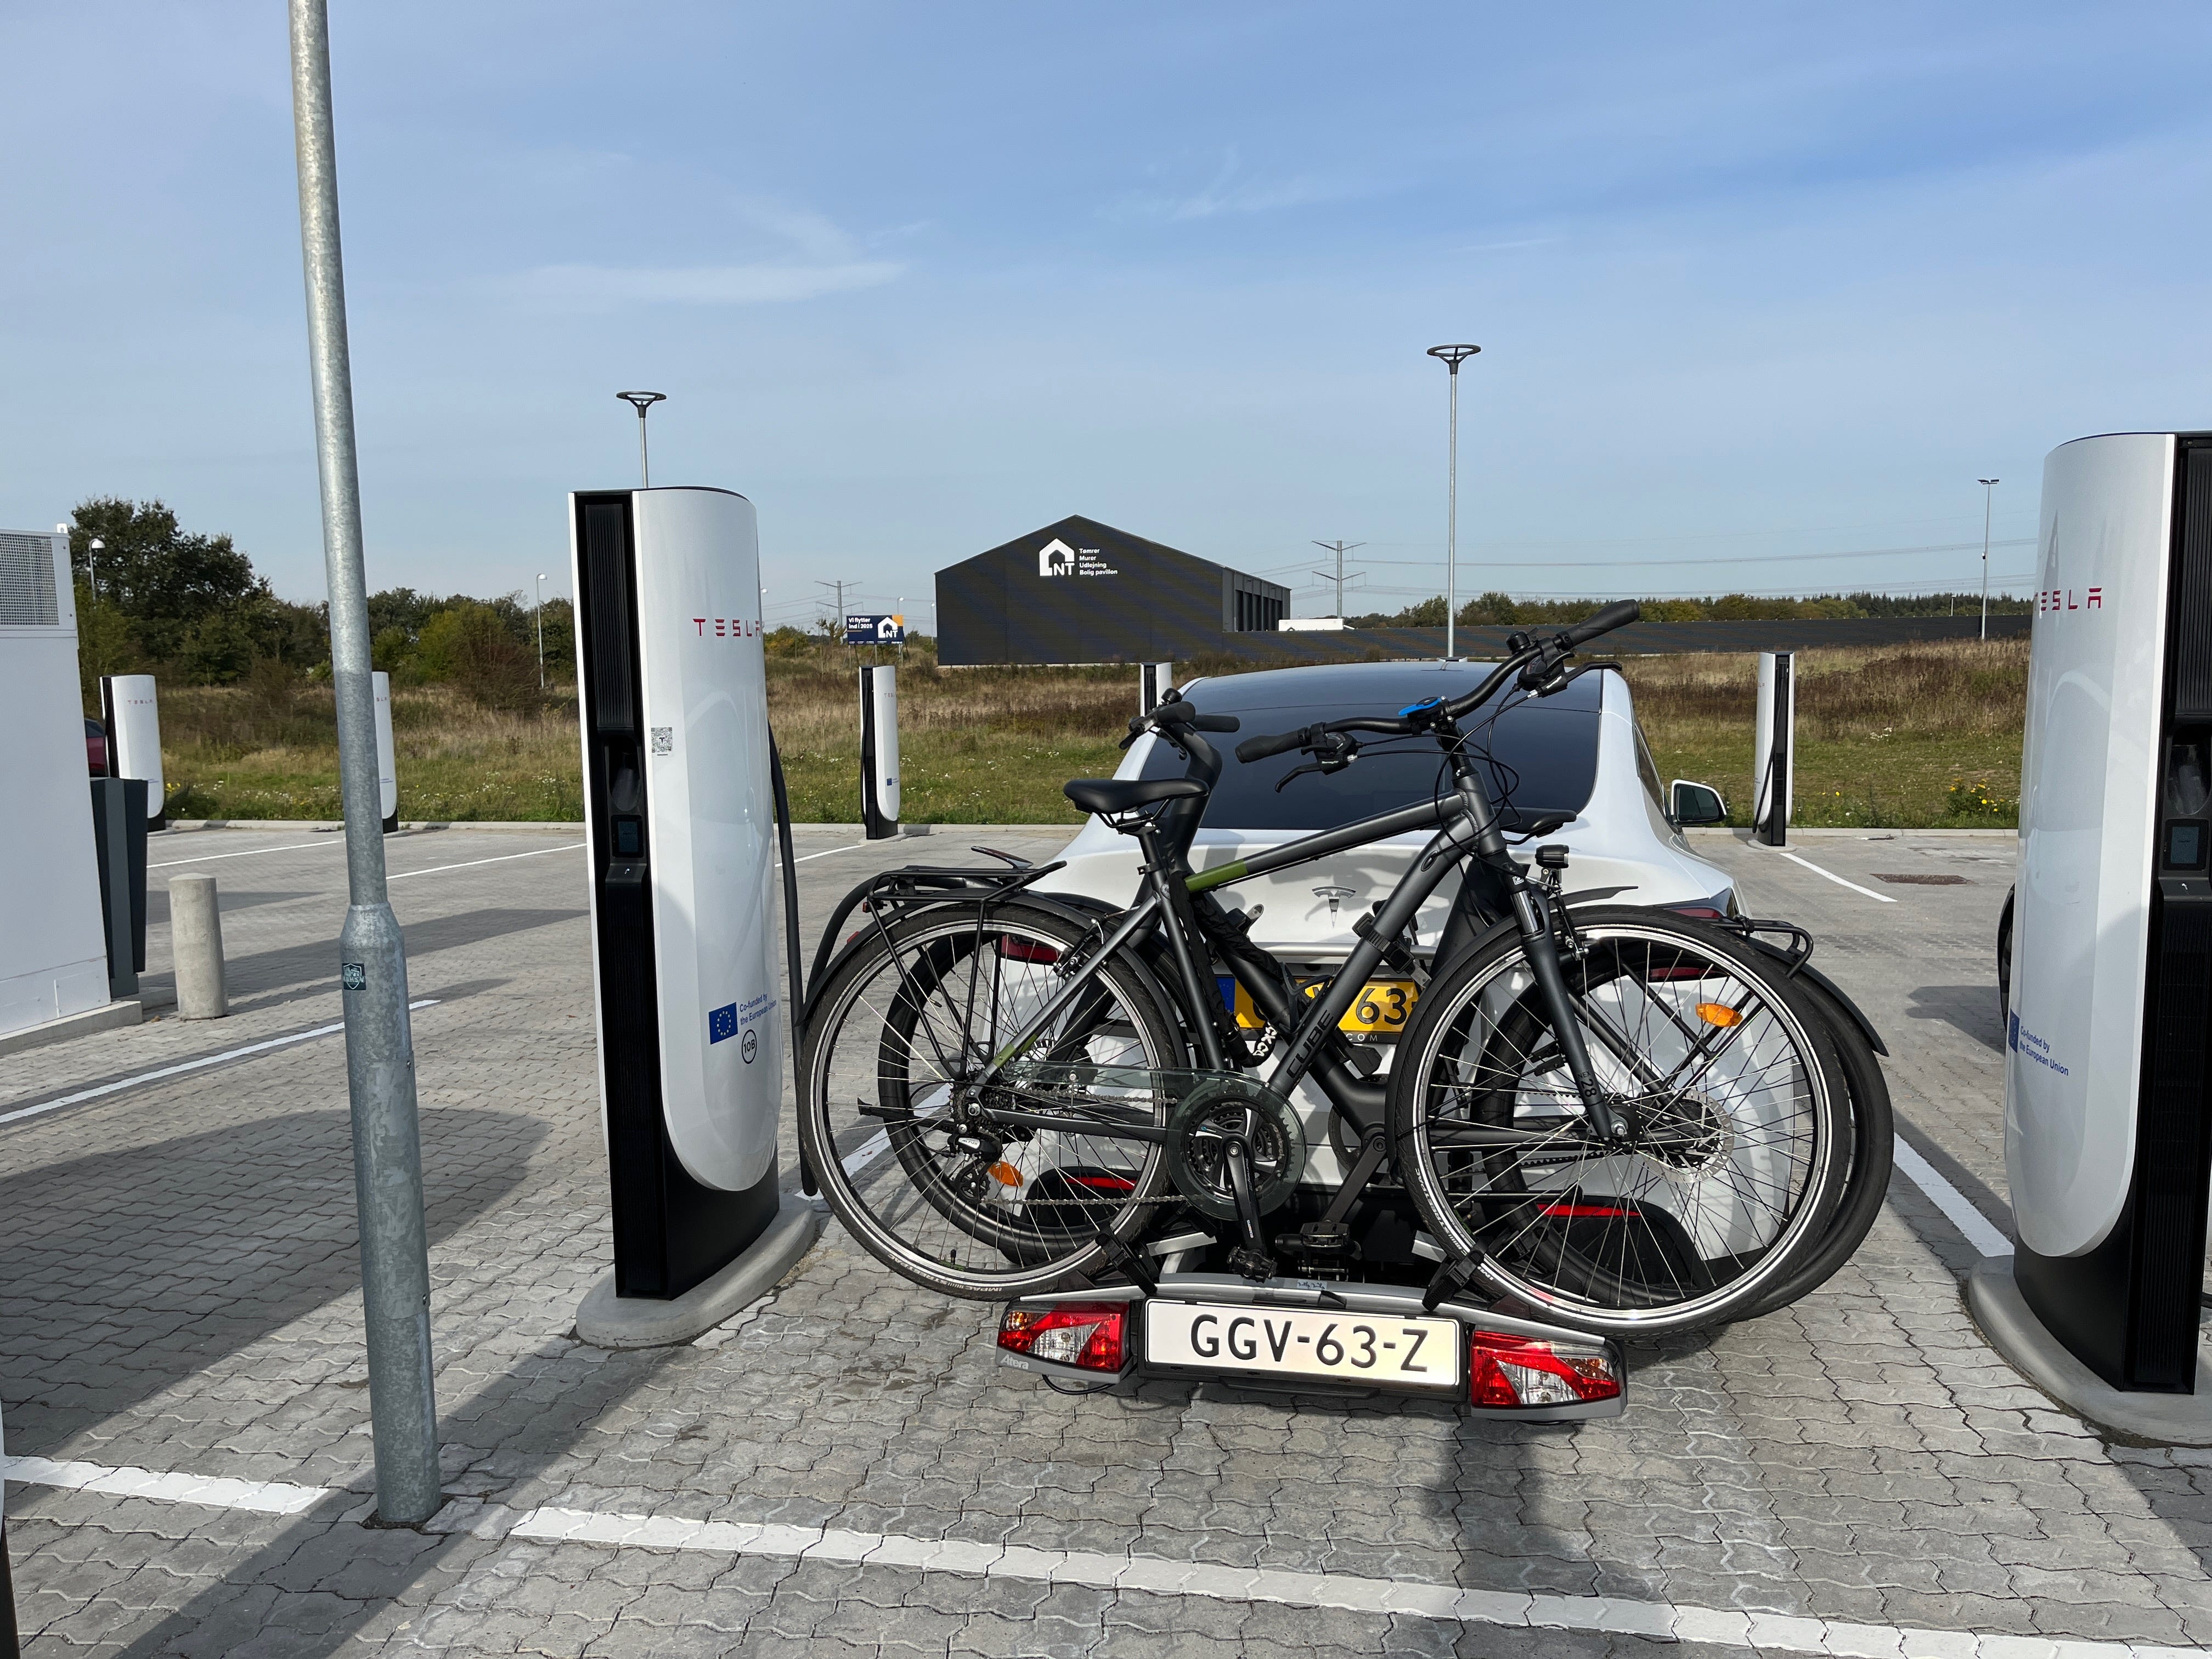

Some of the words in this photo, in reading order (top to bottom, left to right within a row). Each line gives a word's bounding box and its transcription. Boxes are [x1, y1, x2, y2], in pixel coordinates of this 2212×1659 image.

[1053, 562, 1075, 576] NT
[740, 994, 763, 1013] Co-funded
[763, 993, 768, 1002] by
[740, 1017, 748, 1025] the
[749, 1005, 769, 1022] European
[743, 1039, 755, 1053] 10B
[1286, 1009, 1334, 1079] CUBE
[2020, 1025, 2042, 1048] Co-funded
[2043, 1039, 2050, 1053] by
[2025, 1045, 2049, 1066] European
[2050, 1058, 2069, 1076] Union
[1580, 1079, 1597, 1097] 28
[1190, 1314, 1429, 1373] GGV-63-Z
[1000, 1353, 1029, 1370] Atera
